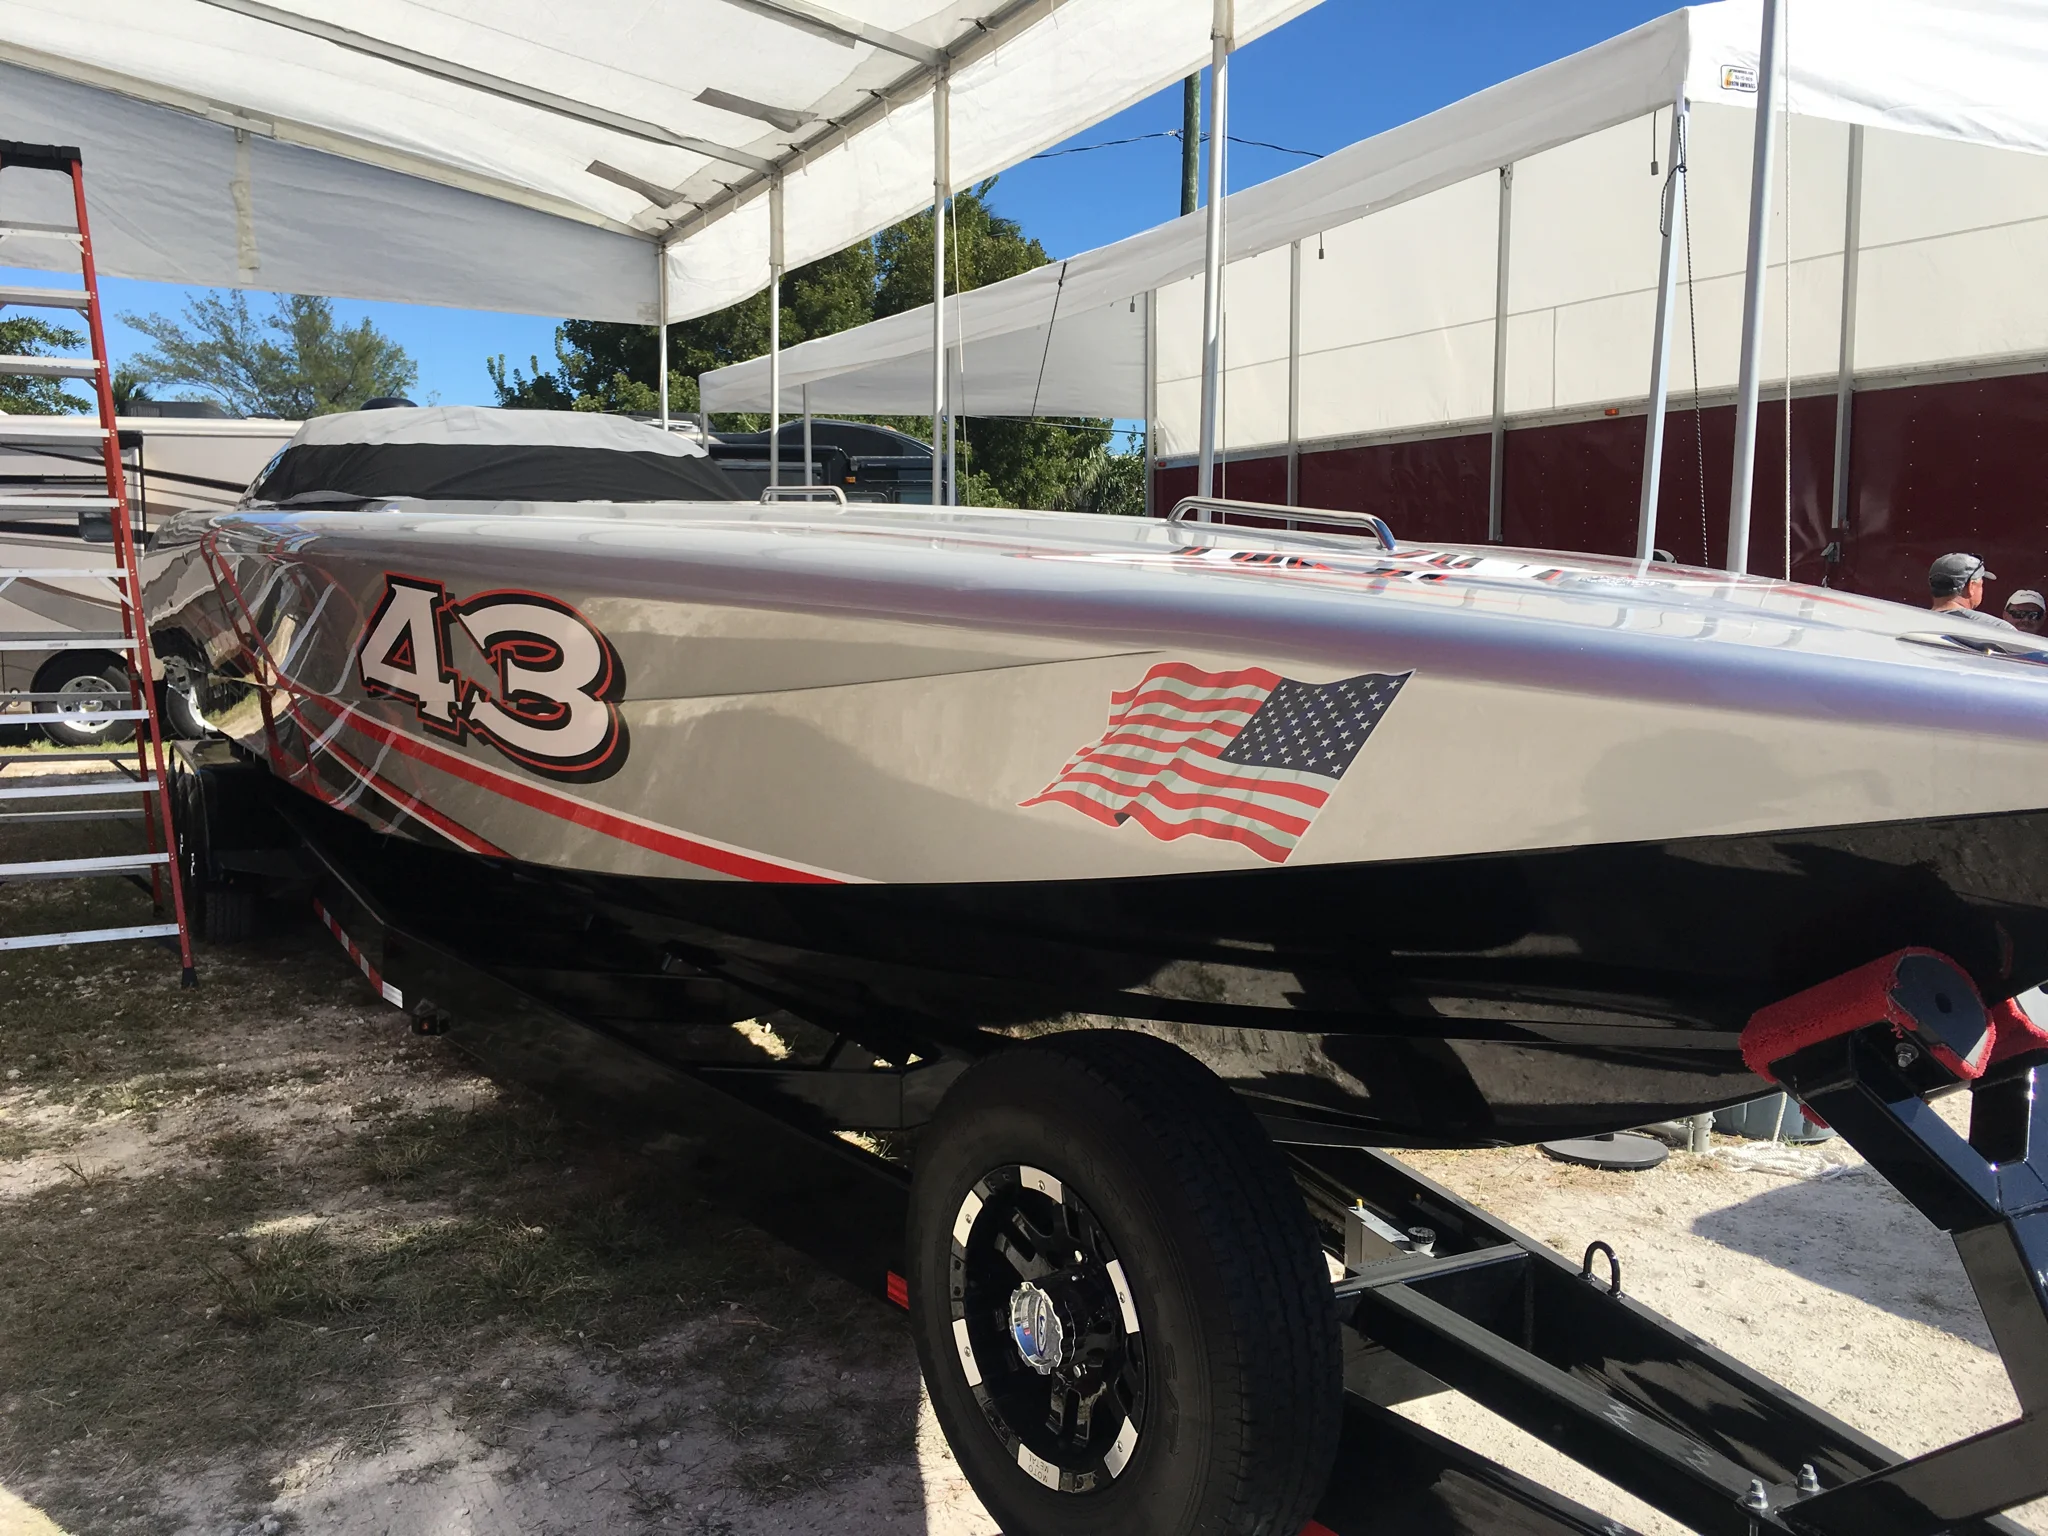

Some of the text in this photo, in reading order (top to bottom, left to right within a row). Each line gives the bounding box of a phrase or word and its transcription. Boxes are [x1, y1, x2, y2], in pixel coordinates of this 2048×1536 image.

[358, 572, 622, 775] 43
[1028, 1453, 1050, 1473] METAL
[1027, 1464, 1048, 1483] MOTO
